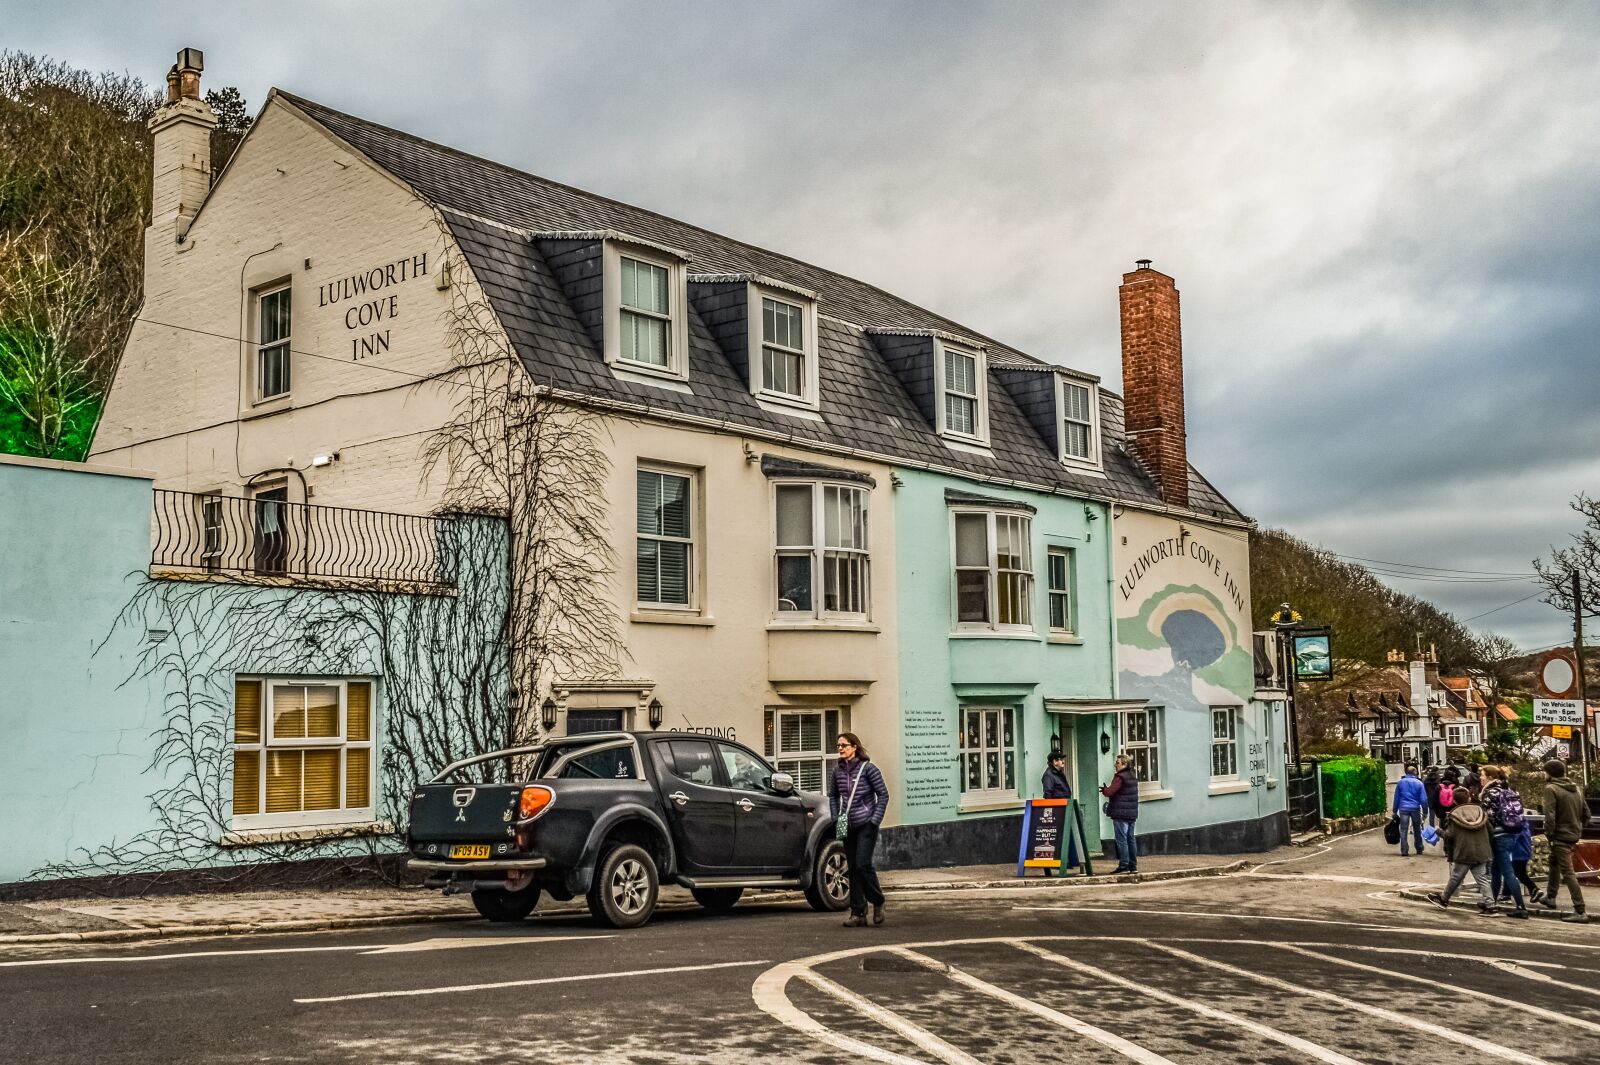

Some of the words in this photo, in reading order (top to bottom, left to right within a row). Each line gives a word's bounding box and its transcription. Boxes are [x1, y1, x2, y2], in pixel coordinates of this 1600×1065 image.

[318, 252, 428, 308] LULWORTH
[345, 294, 399, 330] COVE
[351, 329, 391, 361] INN
[1119, 537, 1185, 601] LULWORTH
[1190, 541, 1221, 577] COVE
[1223, 571, 1245, 613] INN
[453, 845, 472, 856] WF09
[473, 845, 489, 856] ASV
